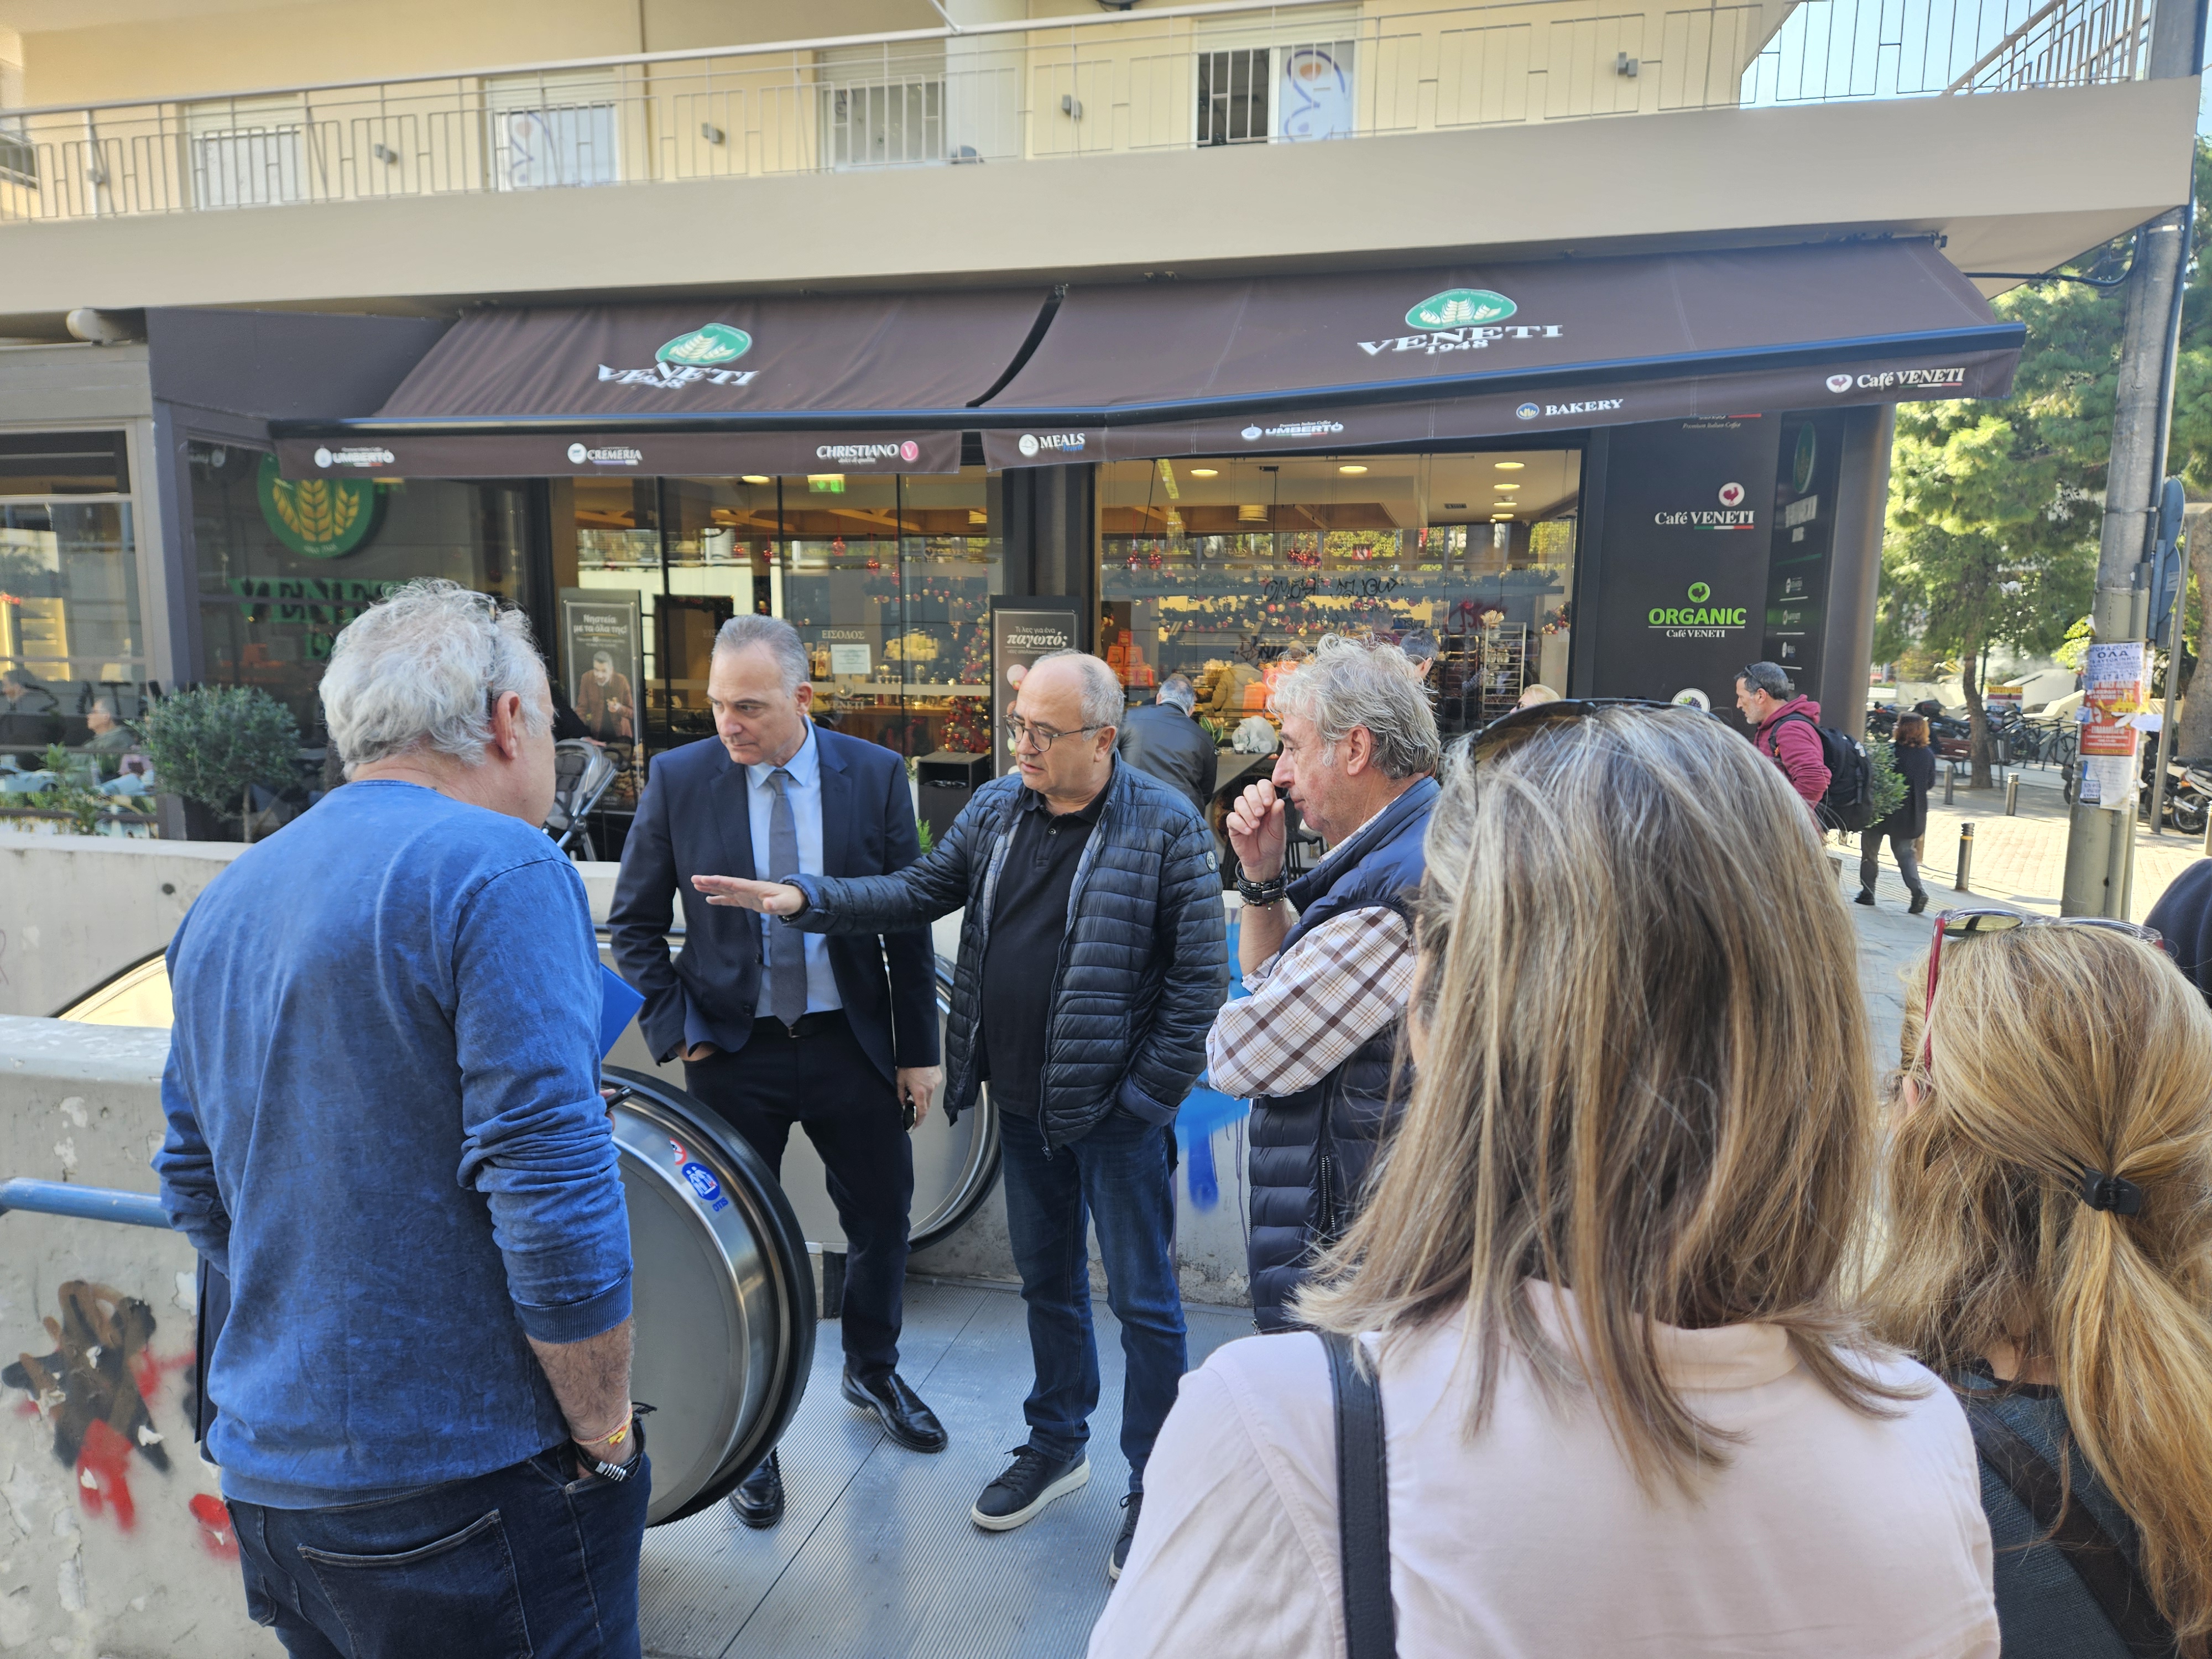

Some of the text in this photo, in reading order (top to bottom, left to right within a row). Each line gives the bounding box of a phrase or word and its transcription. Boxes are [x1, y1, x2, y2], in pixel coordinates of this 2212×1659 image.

[1357, 325, 1563, 356] VENETI
[1425, 338, 1489, 354] 1948
[1856, 367, 1966, 390] Café VENETI
[1545, 398, 1624, 416] BAKERY
[1265, 421, 1344, 435] UMBERTO
[1039, 432, 1085, 449] MEALS
[587, 449, 643, 461] CREMERIA
[816, 444, 900, 460] CHRISTIANO
[1655, 510, 1755, 525] Café VENETI
[1648, 608, 1747, 625] ORGANIC
[822, 630, 865, 639] ΕΙΣΟΔΟΣ
[1006, 631, 1068, 648] παγωτό;
[1666, 629, 1725, 638] Café VENETI
[825, 700, 864, 710] VENETI
[712, 1197, 728, 1212] OTIS
